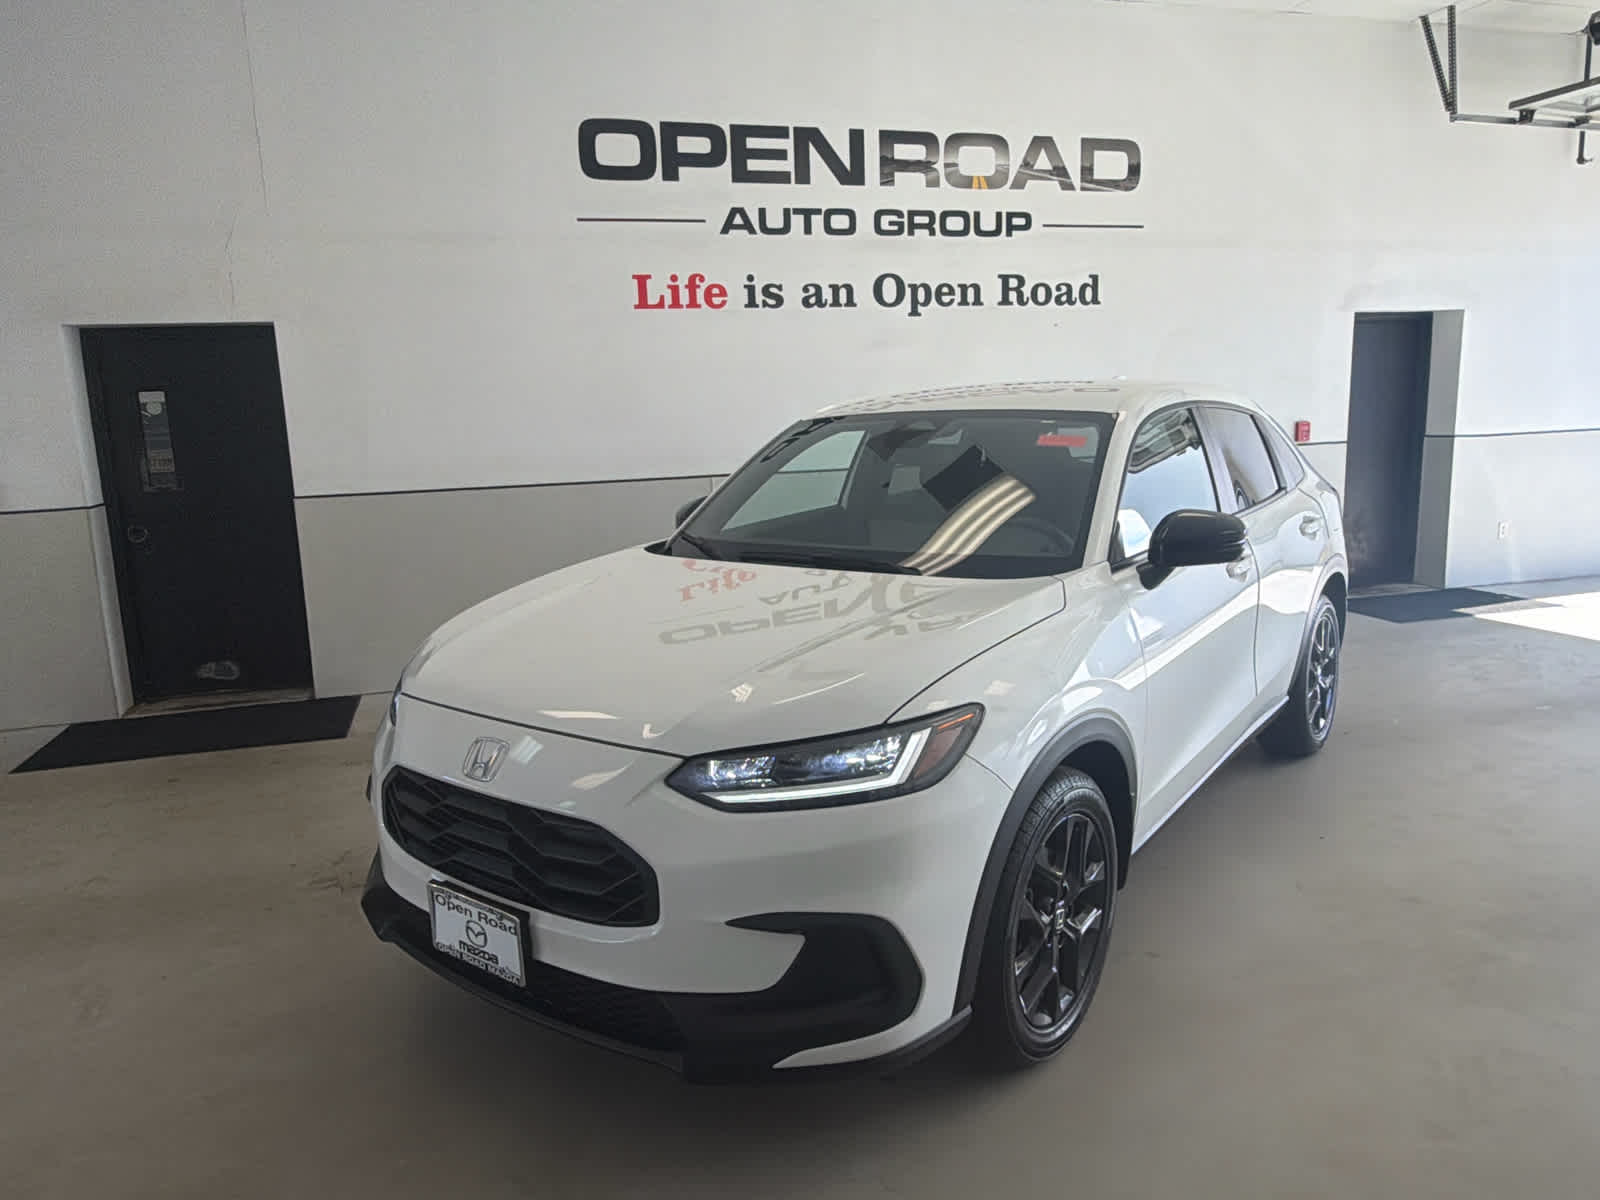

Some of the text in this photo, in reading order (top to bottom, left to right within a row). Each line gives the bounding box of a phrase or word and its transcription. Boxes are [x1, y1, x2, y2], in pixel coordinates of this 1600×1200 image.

[578, 118, 1142, 192] OPEN ROAD
[719, 206, 1033, 238] AUTO GROUP
[631, 272, 1101, 317] Life is an Open Road
[435, 894, 518, 936] Open Road
